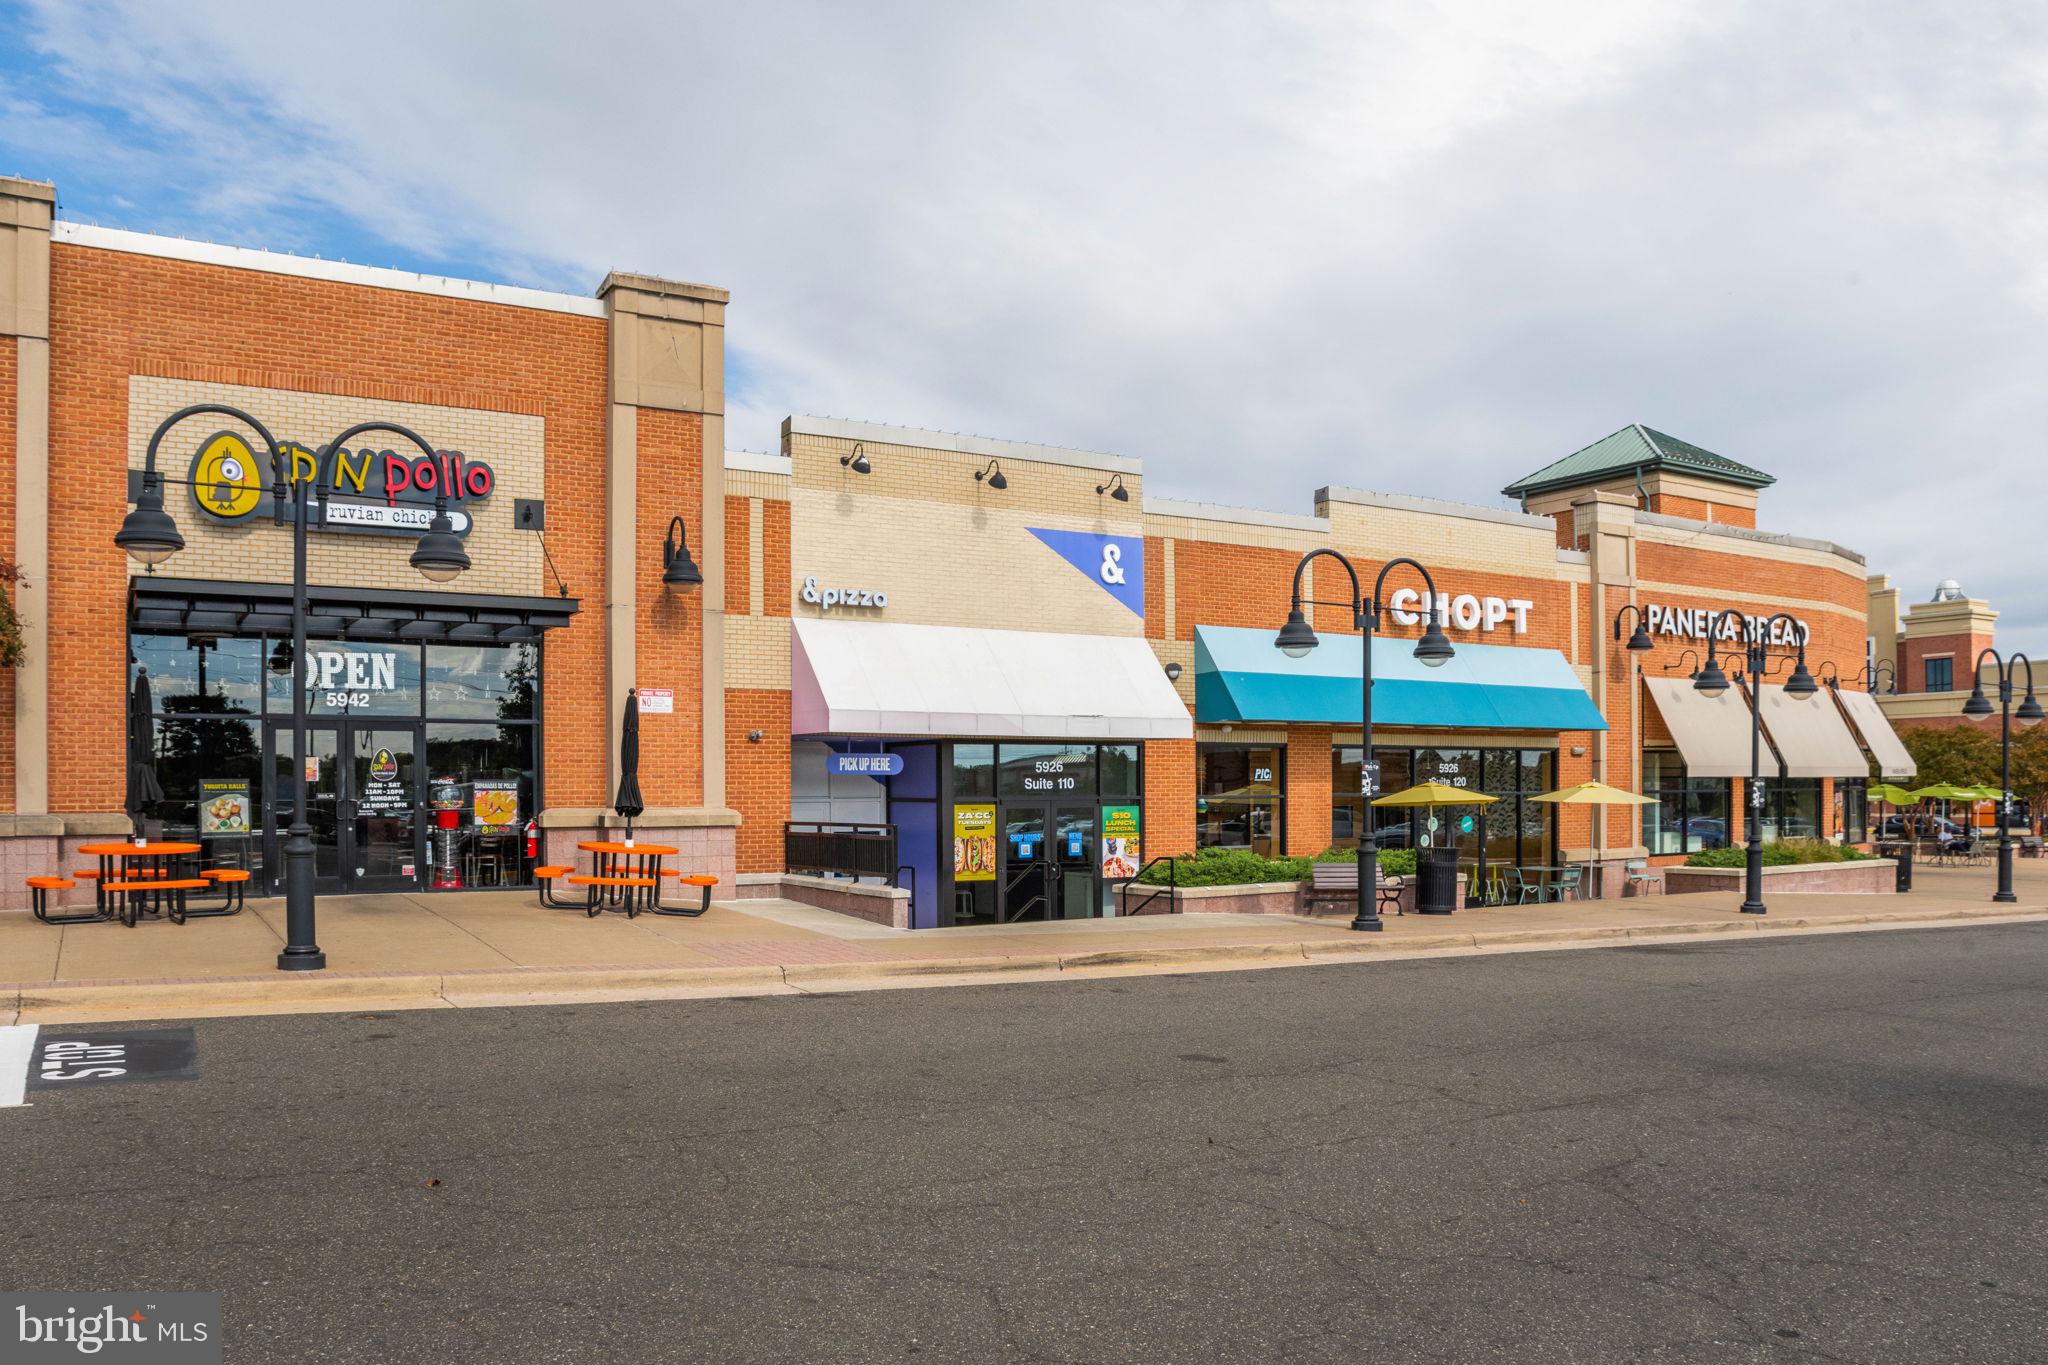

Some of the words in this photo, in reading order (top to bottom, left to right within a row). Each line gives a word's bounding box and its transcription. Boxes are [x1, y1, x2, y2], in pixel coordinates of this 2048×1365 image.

[329, 505, 383, 522] ruvian
[1101, 543, 1126, 585] &
[802, 575, 888, 610] &pizza
[1390, 588, 1533, 634] CHOPT
[1646, 604, 1738, 641] PANERA
[326, 692, 370, 708] 5942
[642, 697, 652, 707] NO
[840, 757, 858, 771] PICK
[859, 757, 869, 771] UP
[870, 757, 891, 771] HERE
[1035, 761, 1064, 773] 5926
[1439, 763, 1459, 774] 5926
[1254, 768, 1272, 779] PIC
[1024, 777, 1054, 790] Suite
[1057, 777, 1075, 790] 110
[1453, 777, 1467, 787] 120
[41, 1041, 128, 1080] STOP
